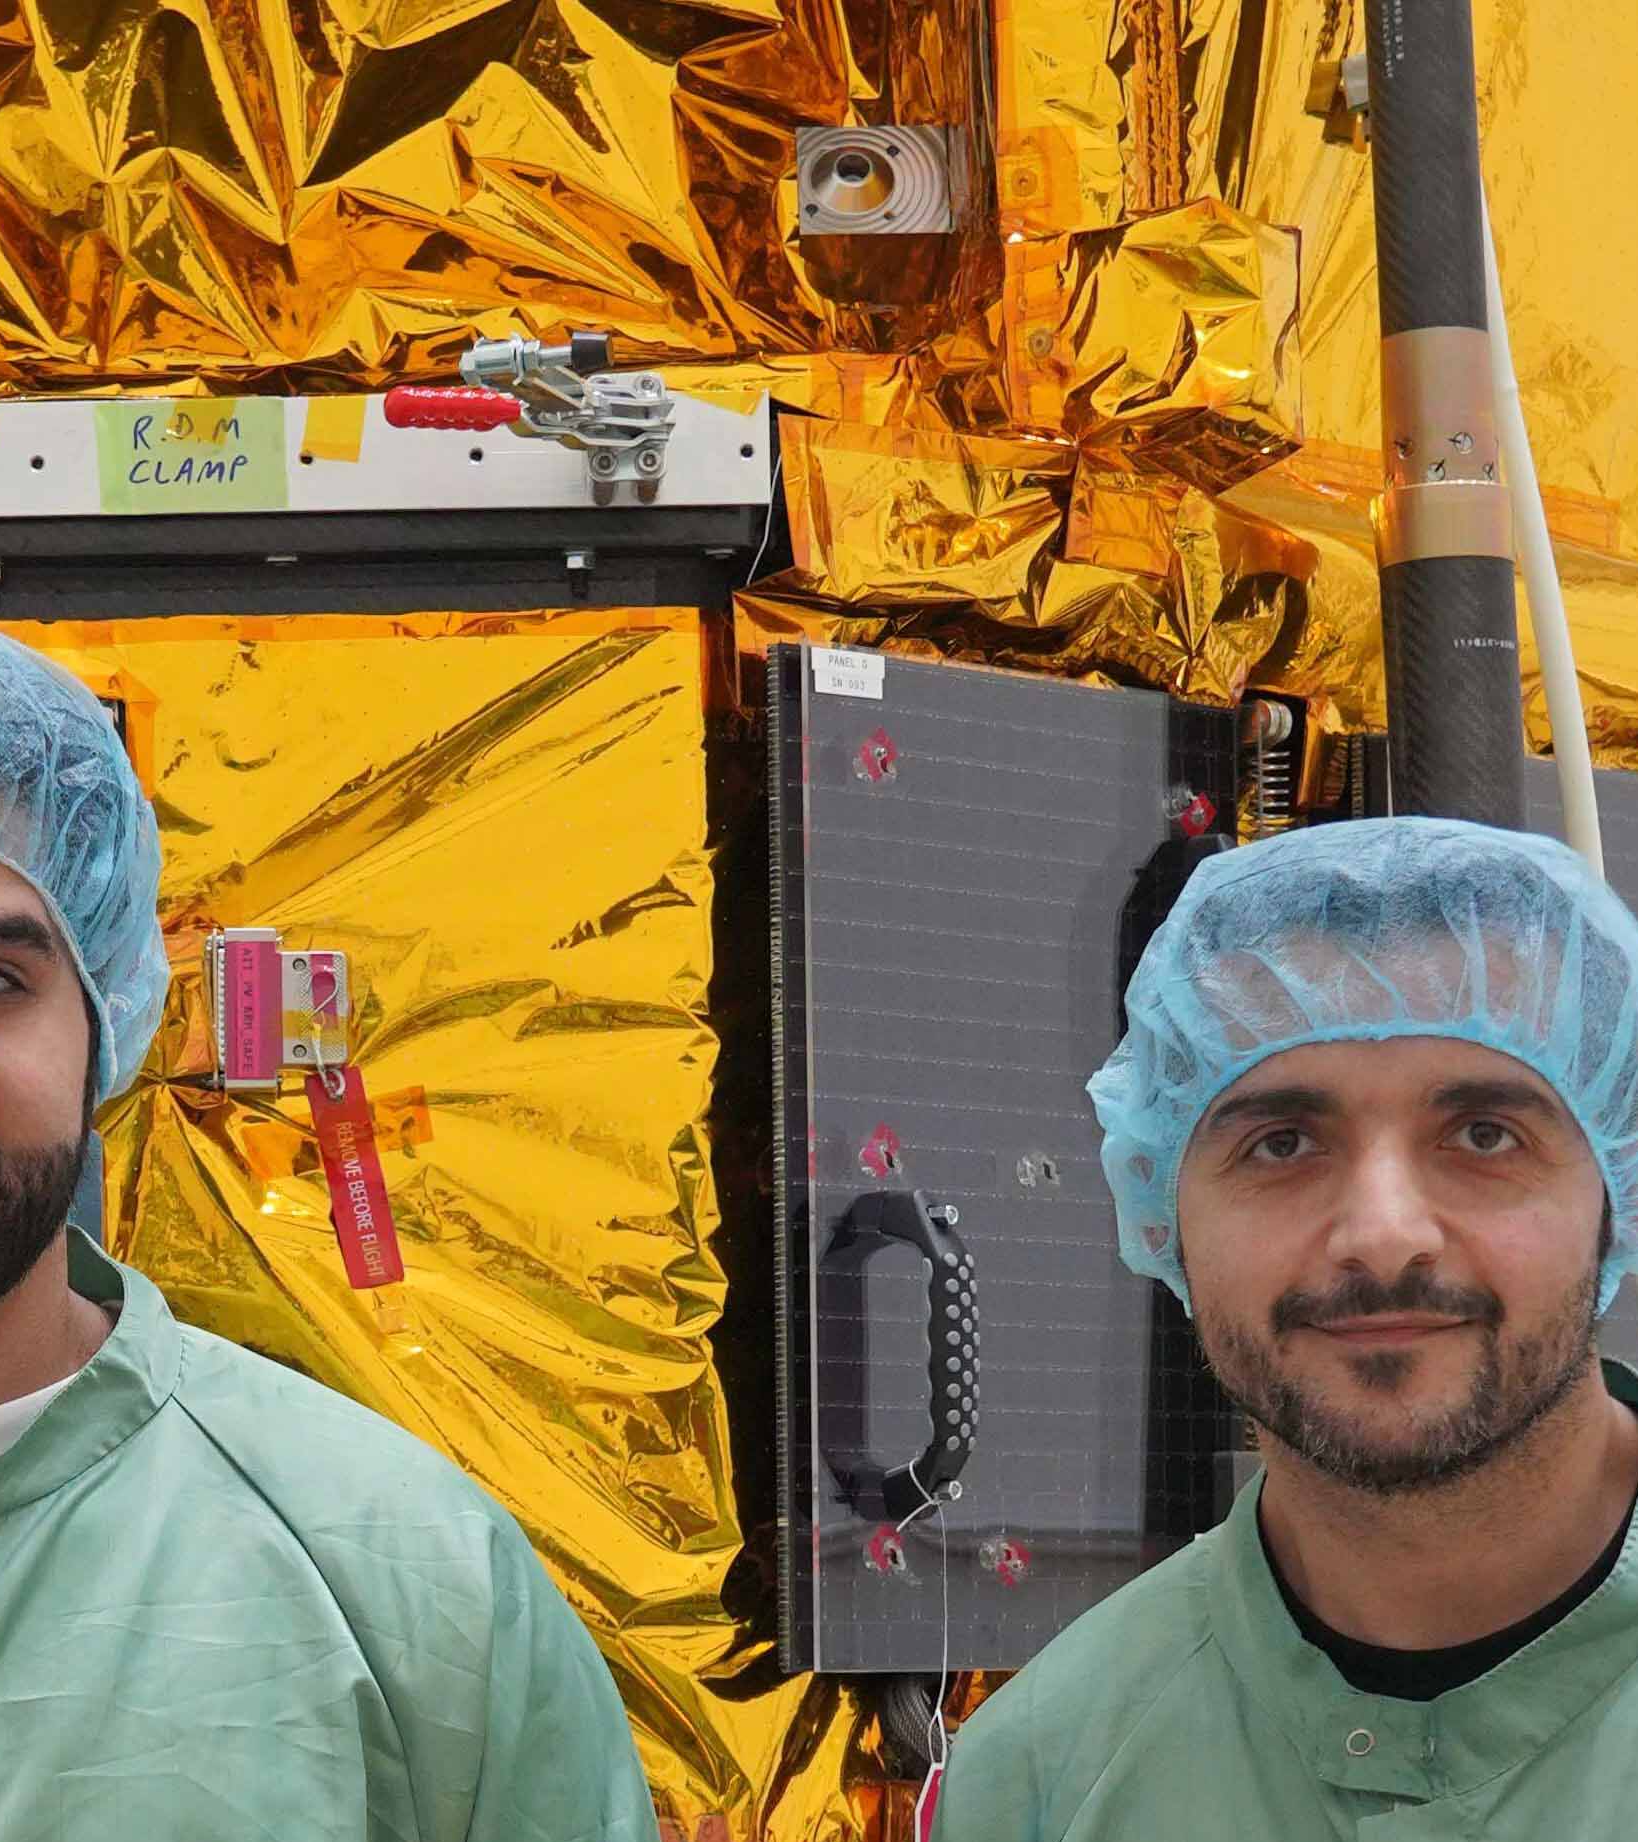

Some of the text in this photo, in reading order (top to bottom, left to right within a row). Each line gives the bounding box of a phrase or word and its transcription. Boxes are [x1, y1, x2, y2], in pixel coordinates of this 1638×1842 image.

[129, 455, 248, 485] CLAMP
[828, 654, 856, 668] PANEL
[243, 1039, 253, 1073] SAFE
[339, 1121, 386, 1281] REMOVE BEFORE FLIGHT
